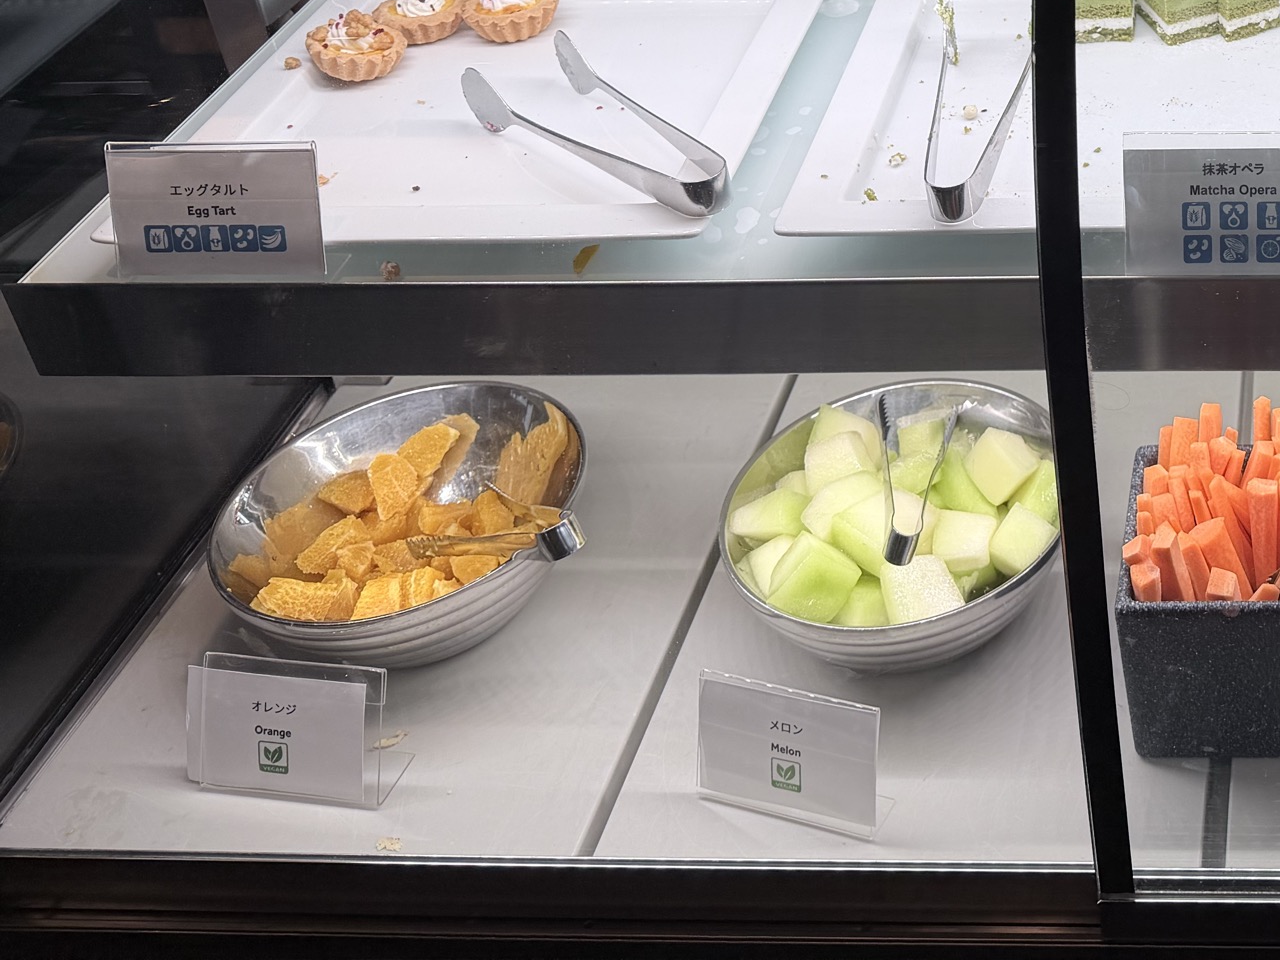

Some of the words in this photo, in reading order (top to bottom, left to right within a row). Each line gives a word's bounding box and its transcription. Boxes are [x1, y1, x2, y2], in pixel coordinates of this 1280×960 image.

[1202, 162, 1265, 176] 抹茶オペラ
[170, 184, 248, 197] エッグタルト
[1189, 184, 1235, 195] Matcha
[1239, 184, 1277, 198] Opera
[187, 206, 209, 218] Egg
[211, 206, 236, 216] Tart
[252, 700, 297, 715] オレンジ
[254, 725, 292, 739] Orange
[770, 720, 803, 734] メロン
[771, 742, 801, 757] Melon
[775, 781, 798, 791] VEGAN
